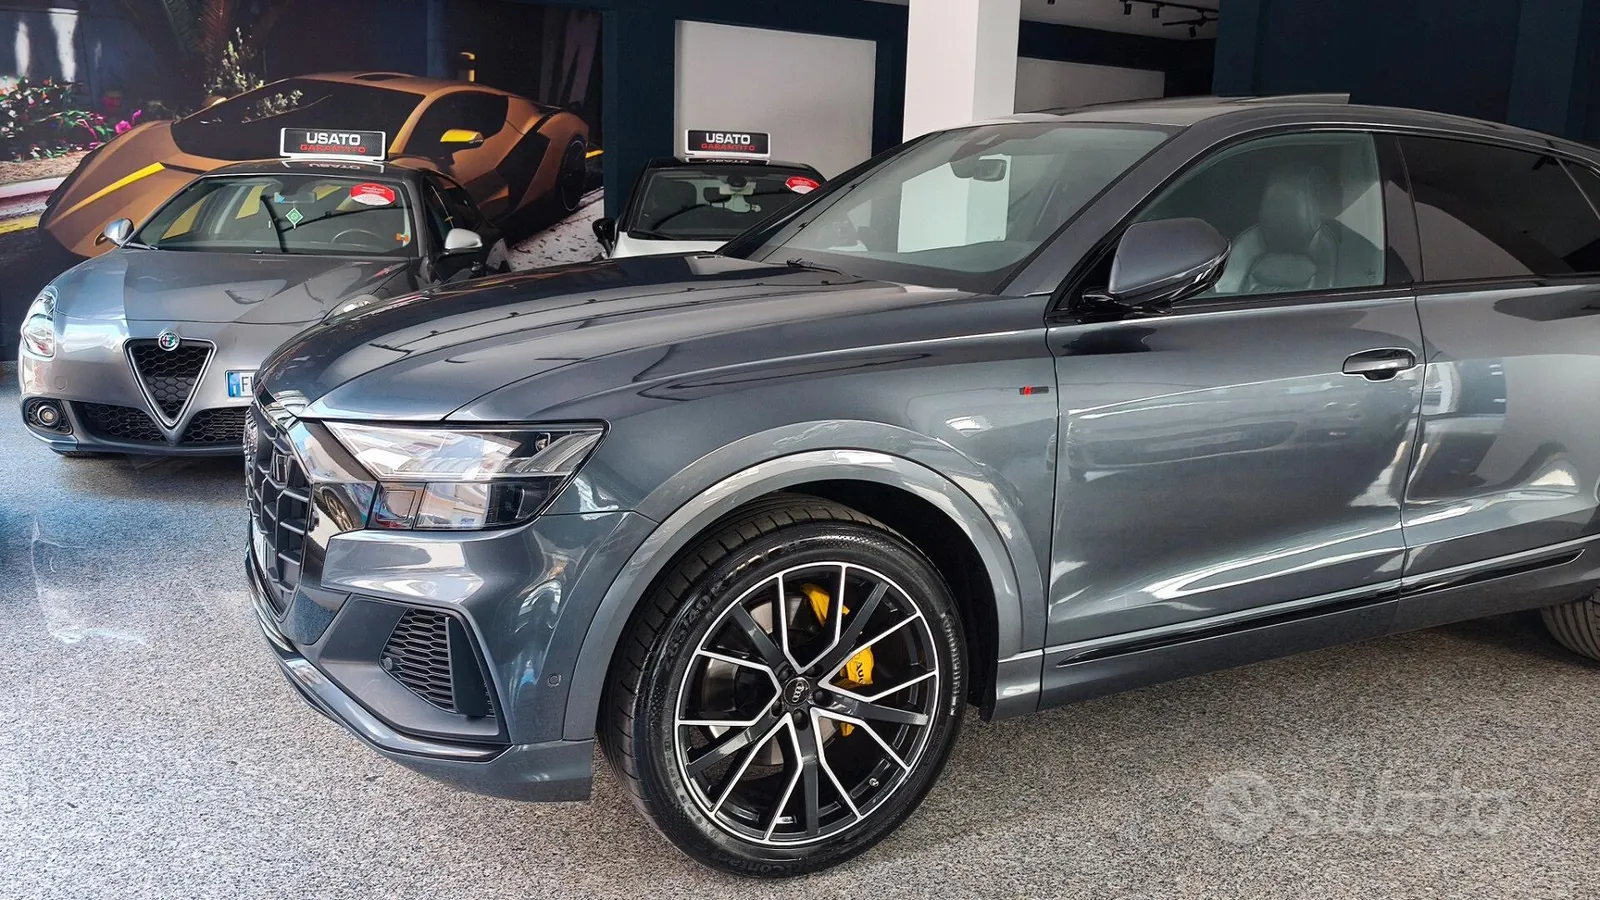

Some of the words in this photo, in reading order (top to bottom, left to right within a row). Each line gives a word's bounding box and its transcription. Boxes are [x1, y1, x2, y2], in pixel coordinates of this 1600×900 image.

[306, 132, 361, 146] USATO
[705, 133, 751, 145] USATO
[701, 143, 756, 152] GARANTITO
